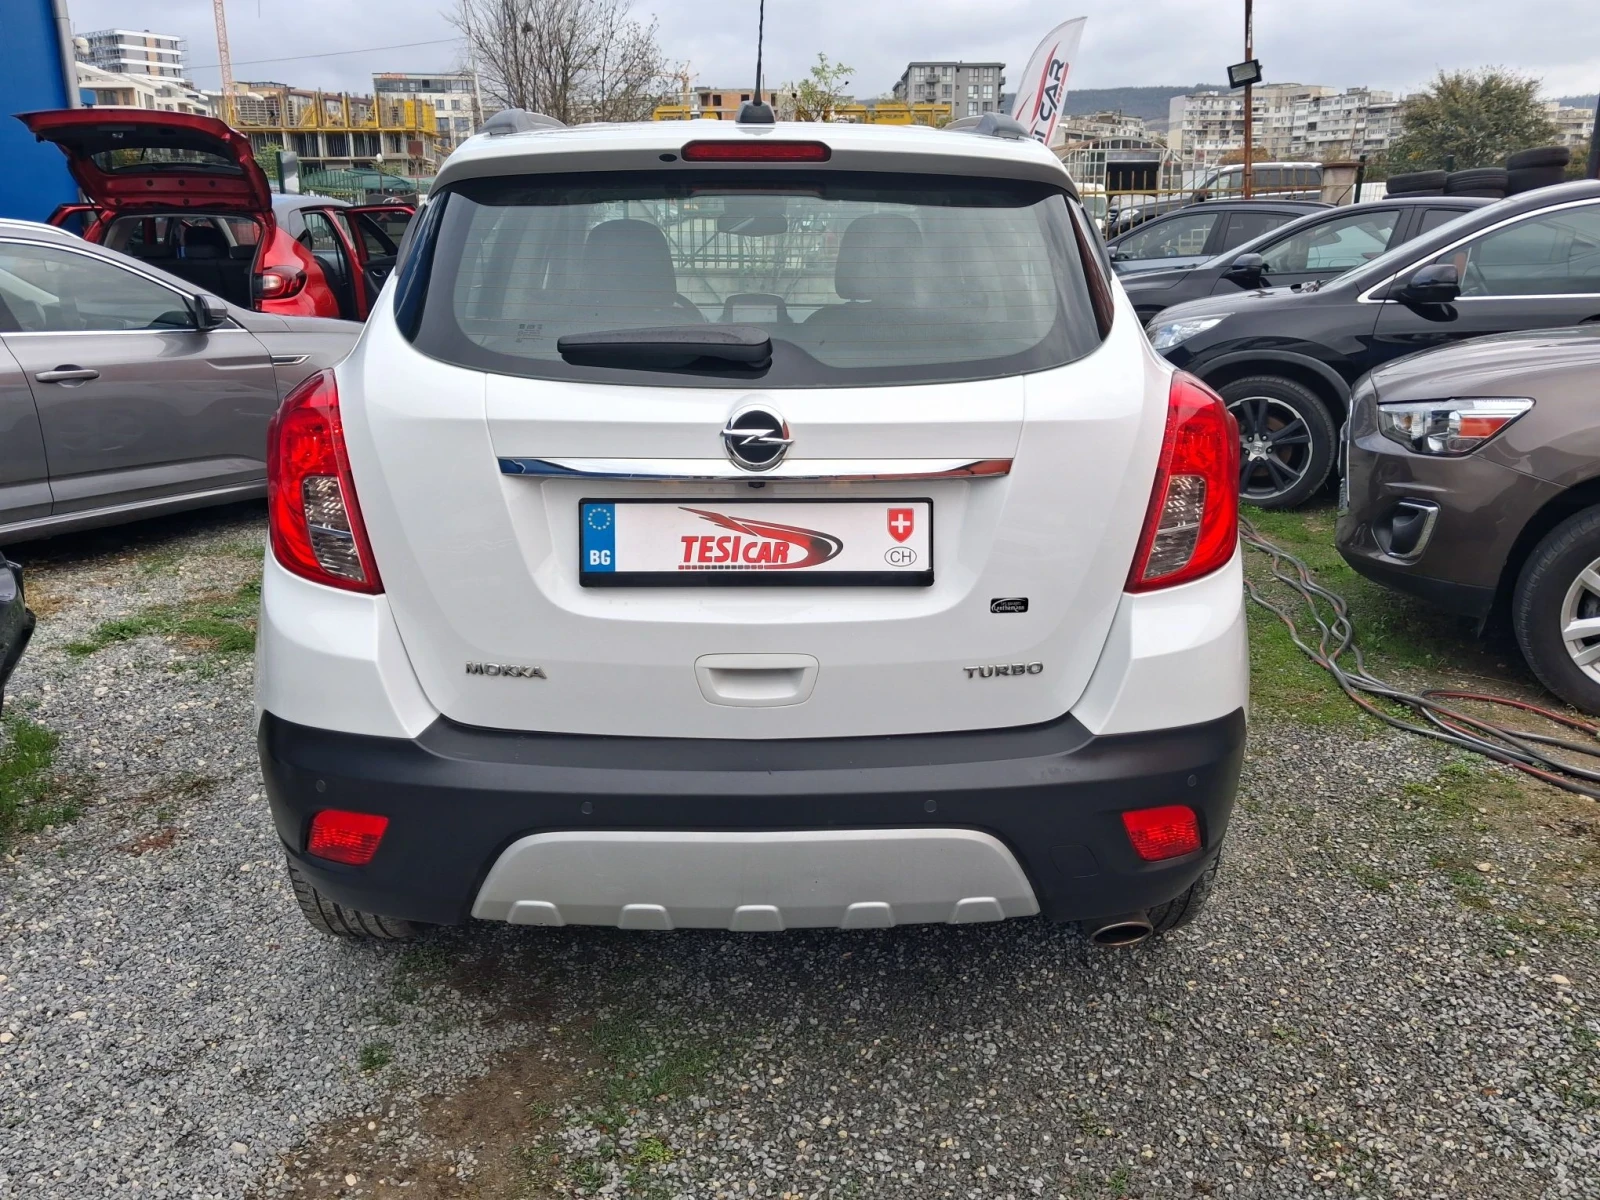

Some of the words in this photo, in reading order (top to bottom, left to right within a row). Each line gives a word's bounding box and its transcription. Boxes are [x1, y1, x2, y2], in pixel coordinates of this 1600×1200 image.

[1040, 58, 1065, 121] CAR
[589, 549, 611, 566] BG
[890, 550, 912, 563] CH
[465, 661, 547, 679] MOKKA
[963, 661, 1044, 679] TURBO
